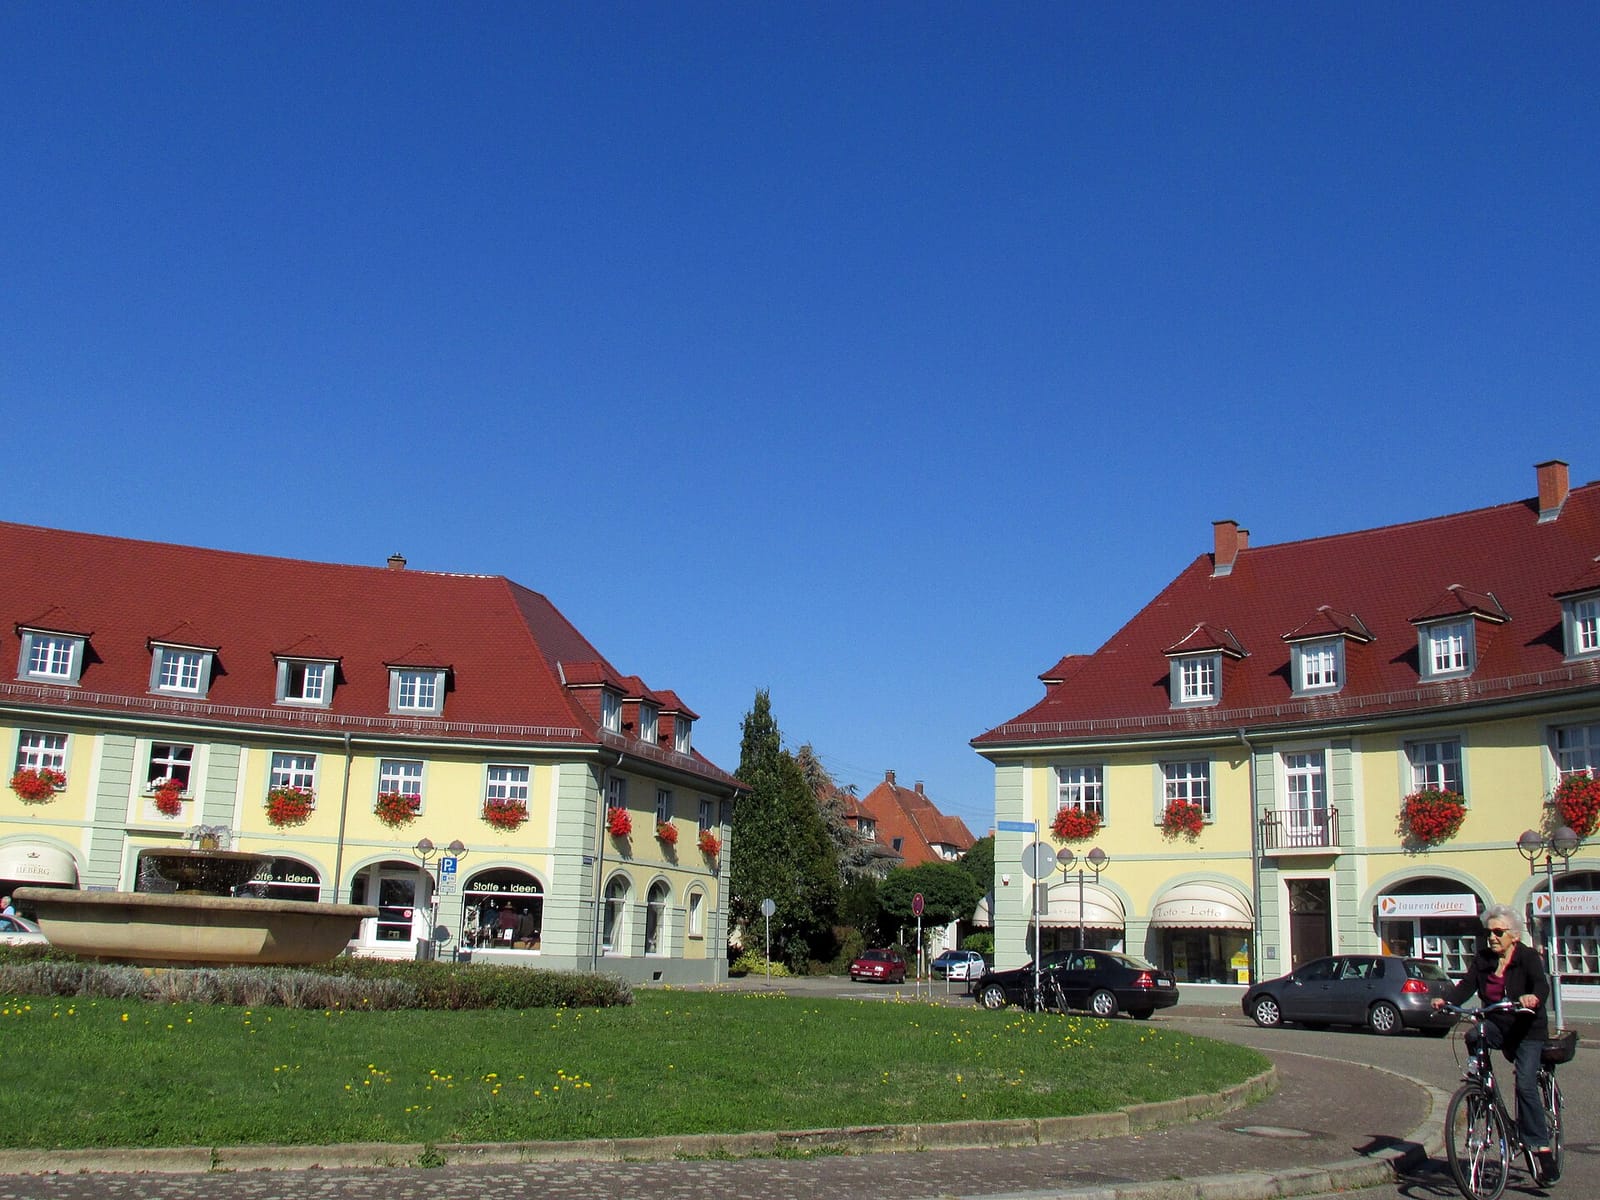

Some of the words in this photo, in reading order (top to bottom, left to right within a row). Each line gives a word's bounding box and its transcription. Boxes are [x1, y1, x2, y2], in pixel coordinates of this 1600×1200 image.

[444, 858, 453, 872] P
[285, 873, 313, 883] Ideen
[473, 882, 499, 891] Stoffe
[510, 883, 537, 893] Ideen
[1157, 907, 1178, 917] Toto
[1190, 905, 1222, 918] Lotto
